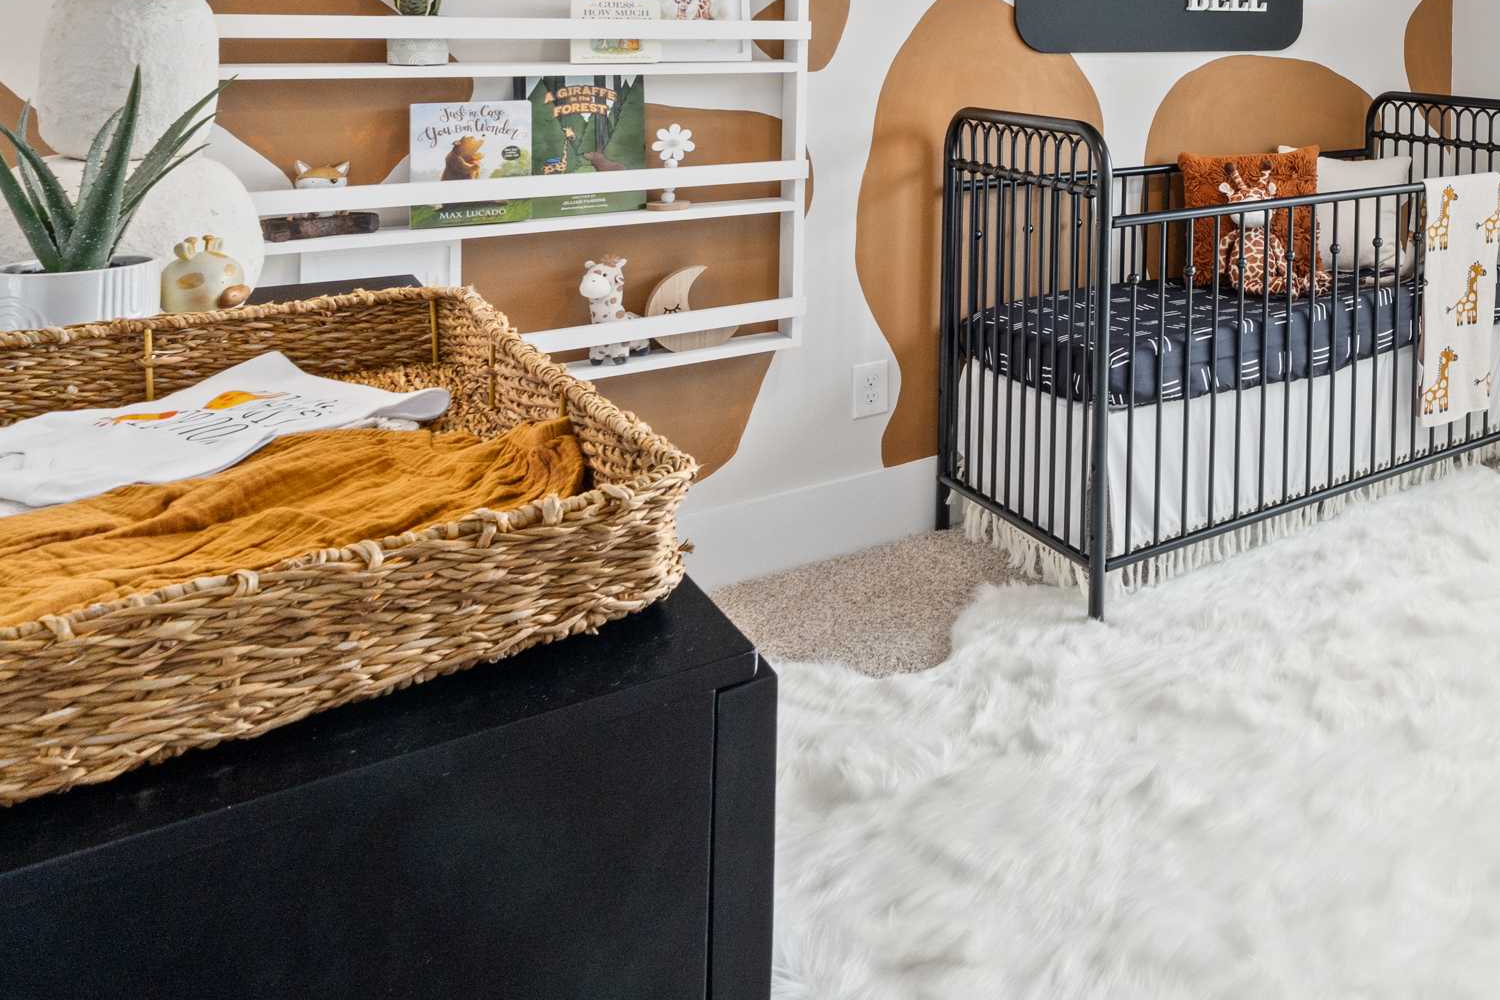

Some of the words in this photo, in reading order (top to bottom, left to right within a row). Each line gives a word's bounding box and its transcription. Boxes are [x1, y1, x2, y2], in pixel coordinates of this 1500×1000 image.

[544, 90, 554, 104] A
[557, 85, 618, 101] GIRAFFE
[441, 105, 465, 122] Just
[553, 103, 608, 119] FOREST
[421, 126, 451, 148] You
[475, 119, 519, 140] Wonder
[440, 210, 463, 219] MAX
[466, 208, 506, 218] LUCADO
